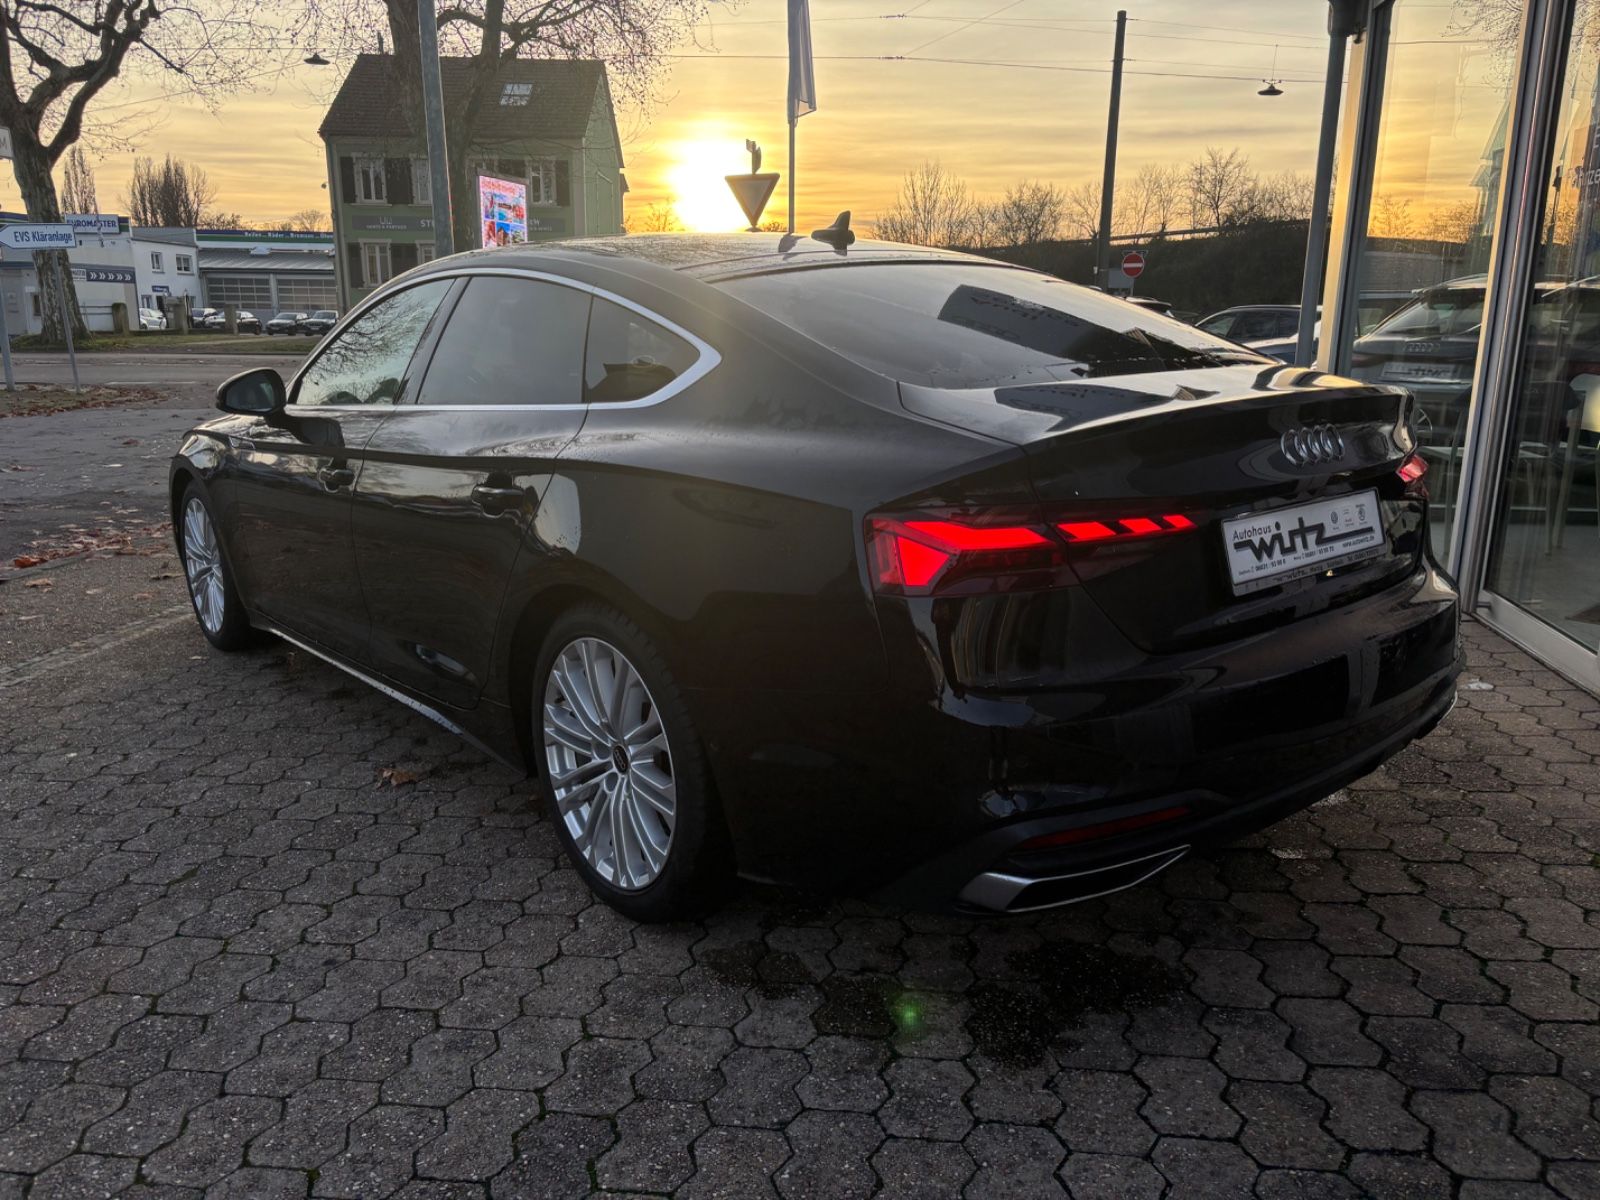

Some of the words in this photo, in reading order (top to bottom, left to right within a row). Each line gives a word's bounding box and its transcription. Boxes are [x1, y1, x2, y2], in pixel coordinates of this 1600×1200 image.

[14, 231, 30, 242] EVS
[32, 231, 73, 244] Kläranlage
[1232, 524, 1272, 541] Autohaus
